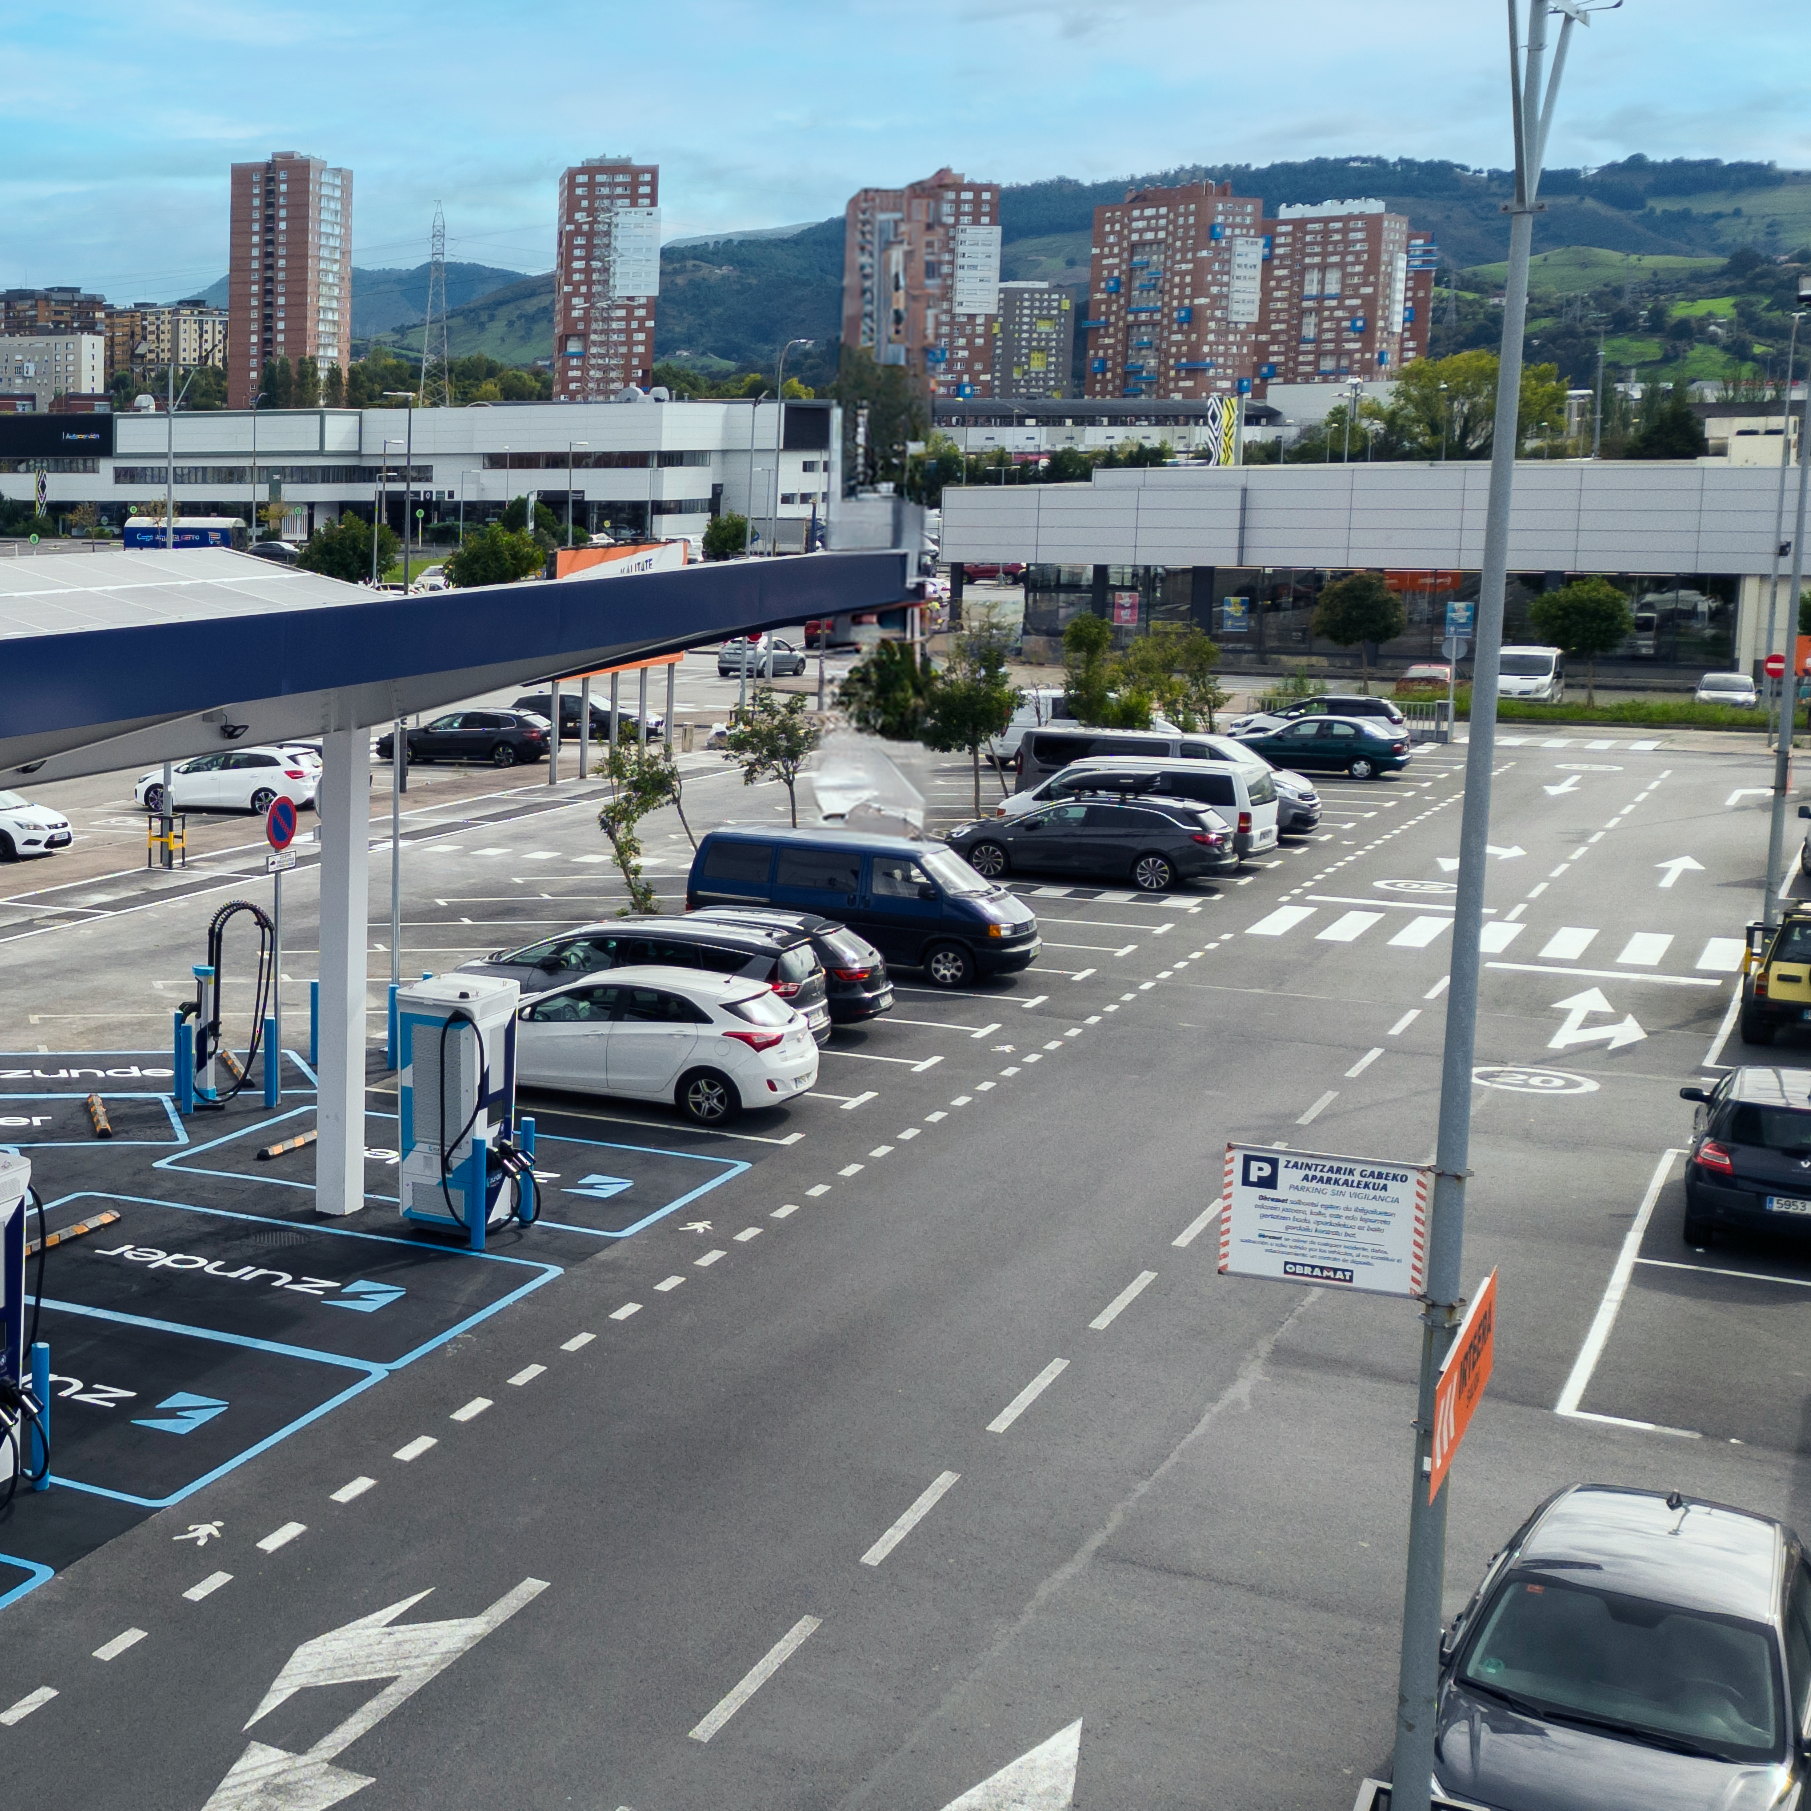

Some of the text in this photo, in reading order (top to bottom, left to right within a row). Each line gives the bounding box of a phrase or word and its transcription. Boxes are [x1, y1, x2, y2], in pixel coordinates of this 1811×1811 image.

[0, 1065, 175, 1078] zunde
[1249, 1160, 1272, 1182] P
[1283, 1159, 1409, 1183] ZAINTZARIK GABEKO
[1301, 1173, 1388, 1192] APARKALEKUA
[1289, 1183, 1400, 1204] PARKING SIN VIGILANCIA
[1776, 1198, 1807, 1211] 5953
[95, 1244, 342, 1295] zunder
[1285, 1263, 1352, 1281] OBRAMAT
